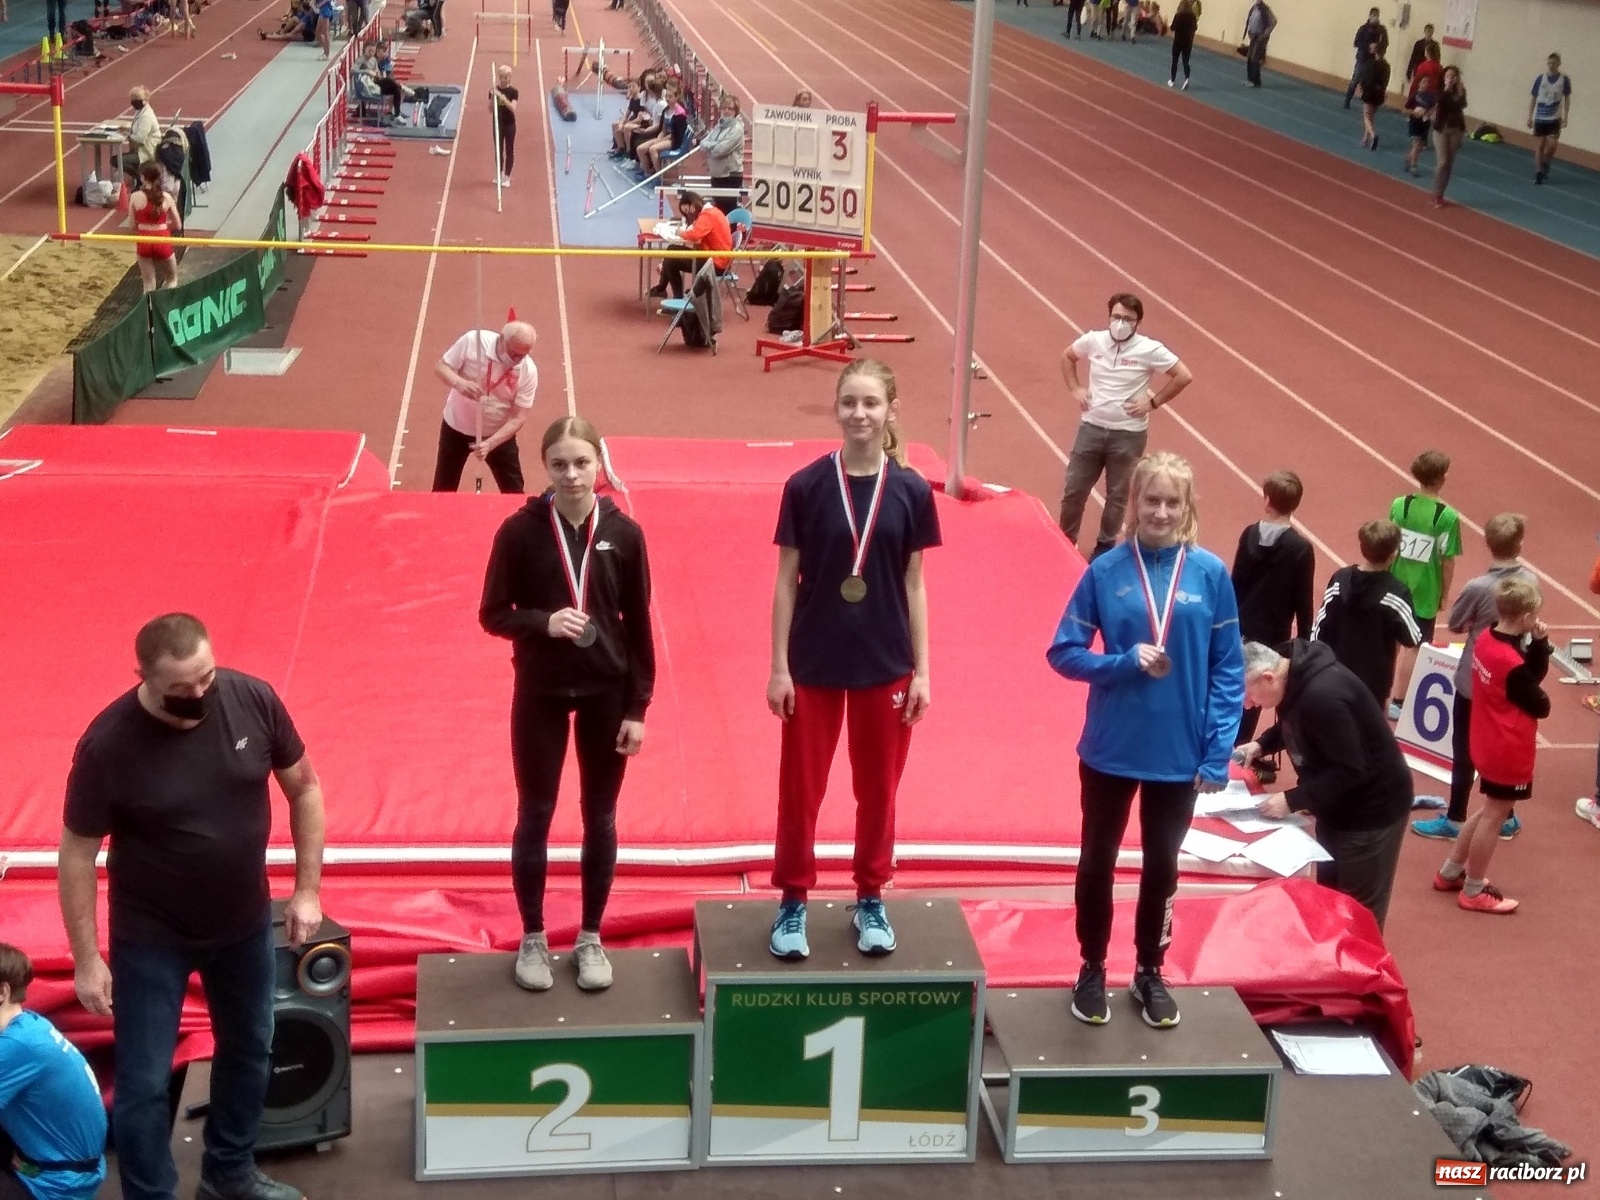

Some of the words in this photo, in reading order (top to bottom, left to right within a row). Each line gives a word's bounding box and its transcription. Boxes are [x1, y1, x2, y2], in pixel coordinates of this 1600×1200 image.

[764, 109, 812, 122] ZAWODNIK
[825, 114, 857, 127] PROBA
[831, 130, 848, 161] 3
[792, 169, 822, 181] WYNIK
[168, 278, 247, 346] DONIC
[1413, 672, 1453, 742] 6
[732, 993, 800, 1007] RUDZKI
[806, 992, 852, 1006] KLUB
[859, 990, 962, 1006] SPORTOWY
[803, 1015, 865, 1142] 1
[526, 1063, 592, 1153] 2
[1124, 1084, 1161, 1137] 3
[908, 1131, 956, 1148] ŁÓDŹ
